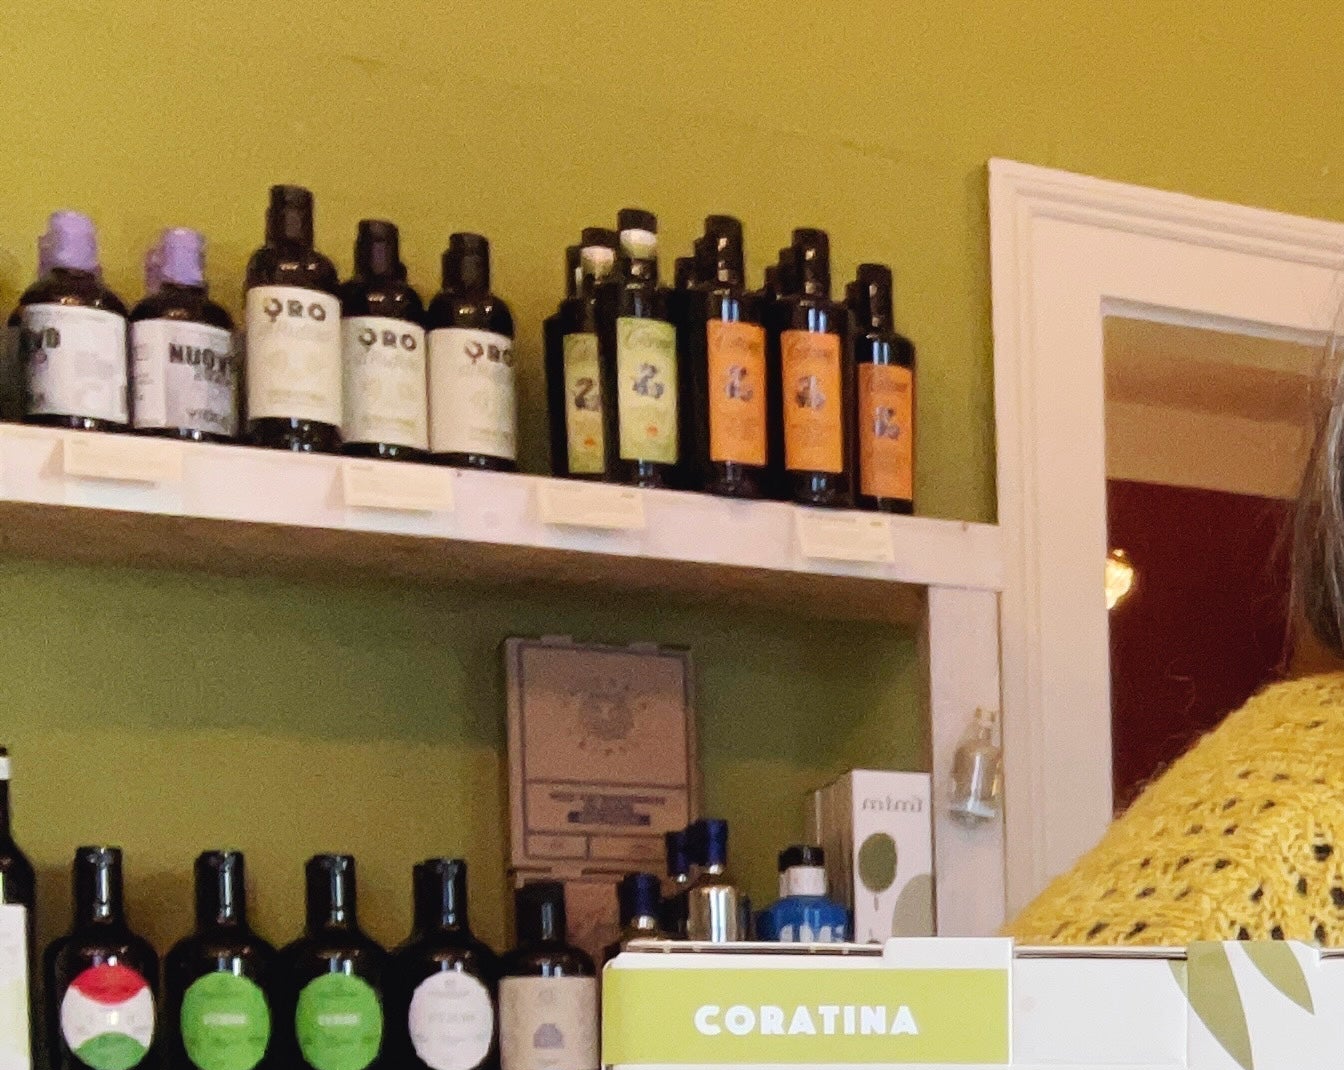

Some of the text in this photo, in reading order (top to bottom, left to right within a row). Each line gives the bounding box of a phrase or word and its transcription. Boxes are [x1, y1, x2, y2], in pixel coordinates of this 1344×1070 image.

[264, 298, 326, 322] ORO
[357, 328, 417, 352] ORO
[693, 1004, 919, 1035] CORATINA
